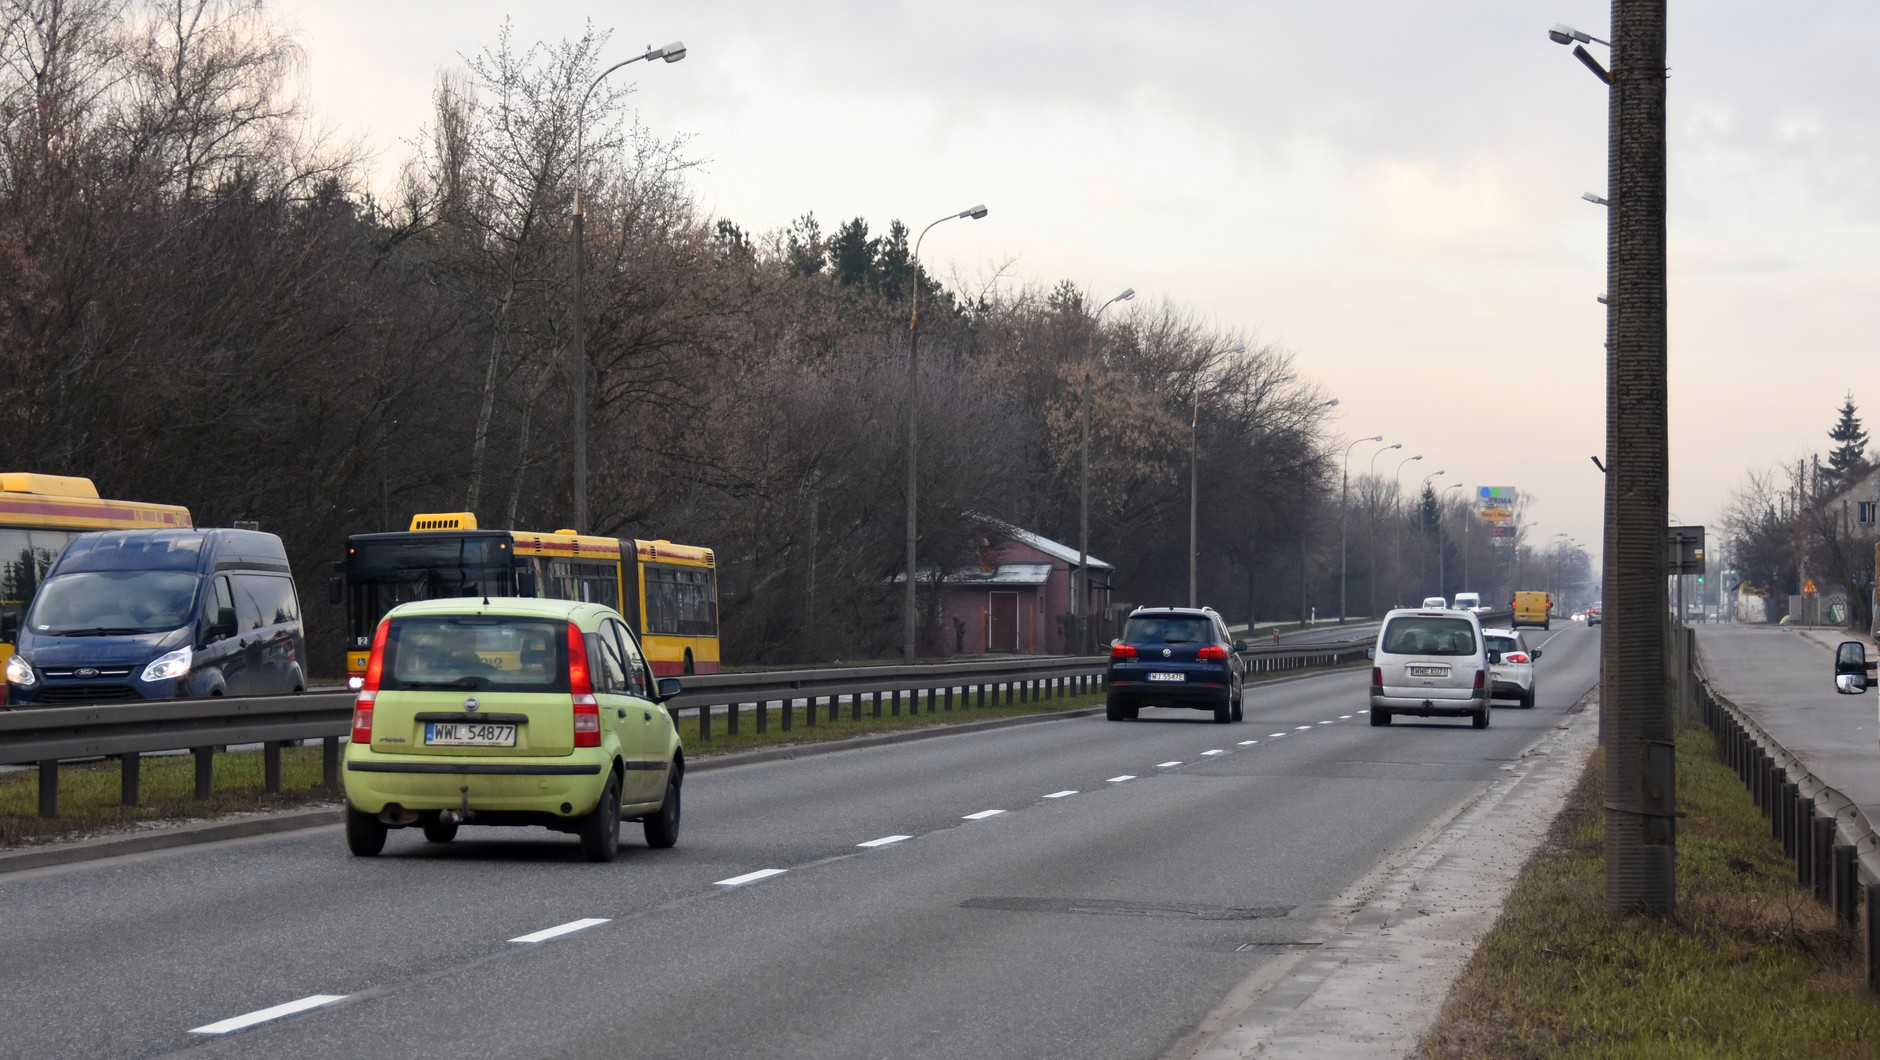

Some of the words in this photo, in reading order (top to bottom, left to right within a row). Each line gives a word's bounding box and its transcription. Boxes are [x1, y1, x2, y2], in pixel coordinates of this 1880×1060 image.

[360, 637, 366, 645] 2
[435, 724, 462, 740] WWL
[467, 725, 514, 741] 54877
